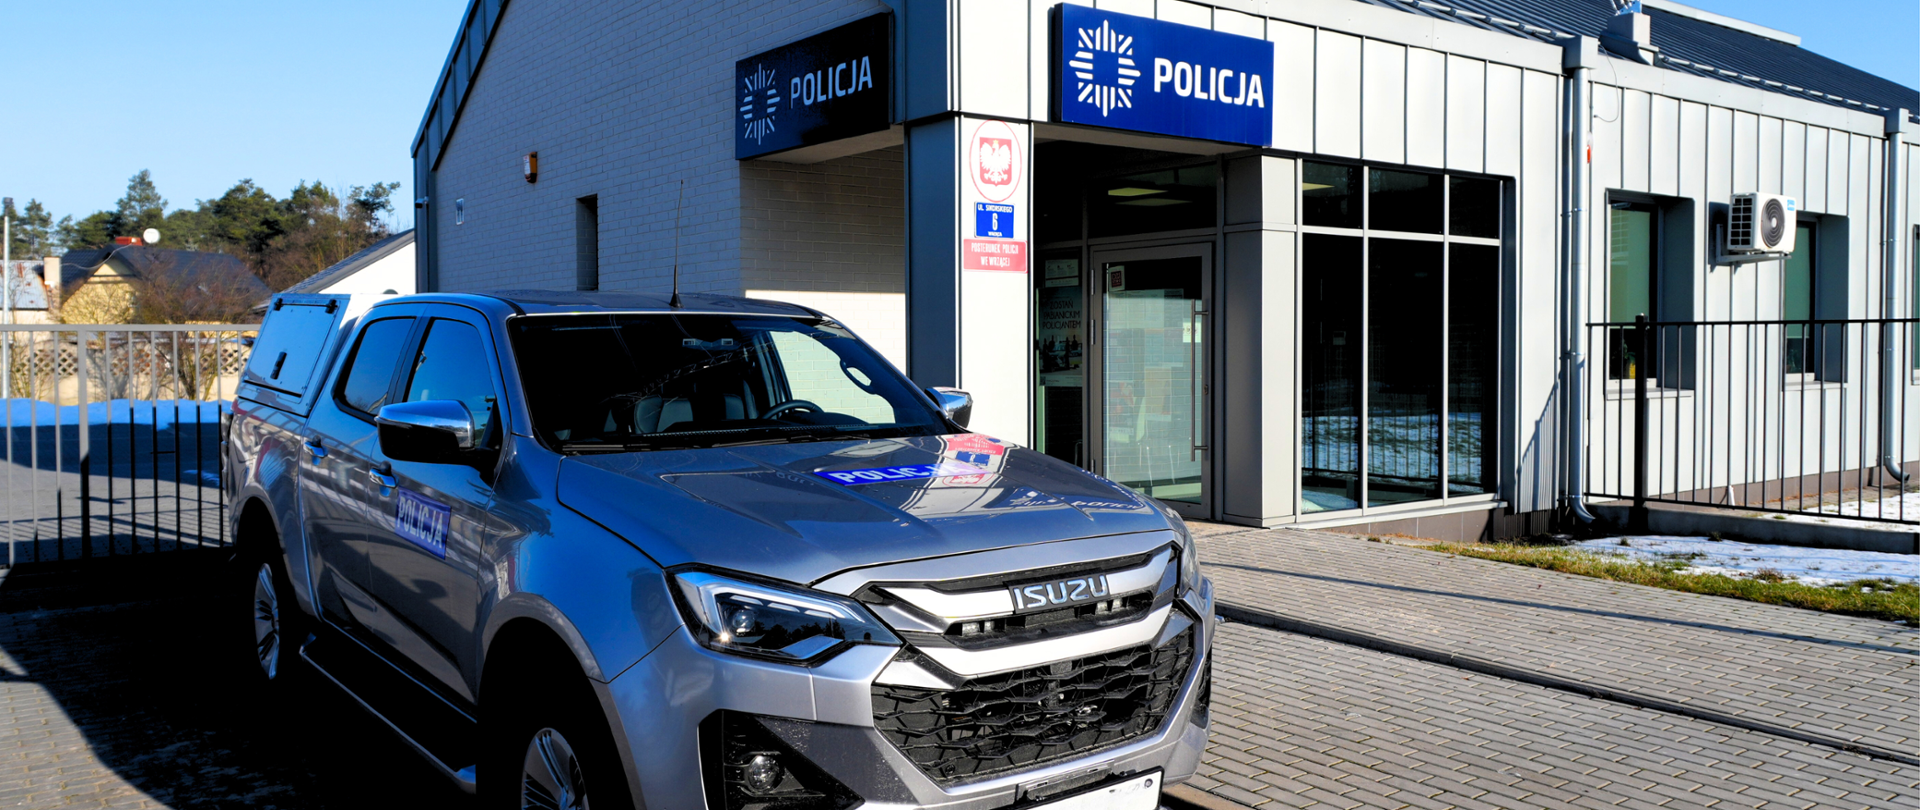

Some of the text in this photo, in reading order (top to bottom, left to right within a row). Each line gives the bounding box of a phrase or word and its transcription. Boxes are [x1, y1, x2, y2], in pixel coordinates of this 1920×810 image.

[789, 55, 873, 109] POLICJA
[1154, 57, 1265, 108] POLICJA
[992, 213, 998, 230] 6
[971, 243, 1000, 254] POSTERUNEK
[980, 256, 989, 266] WE
[1050, 299, 1074, 310] ZOSTAŃ
[1043, 311, 1081, 320] PABIANICKIM
[1042, 320, 1082, 331] POLICJANTEM
[397, 496, 443, 549] POLICJA
[1013, 574, 1109, 610] ISUZU
